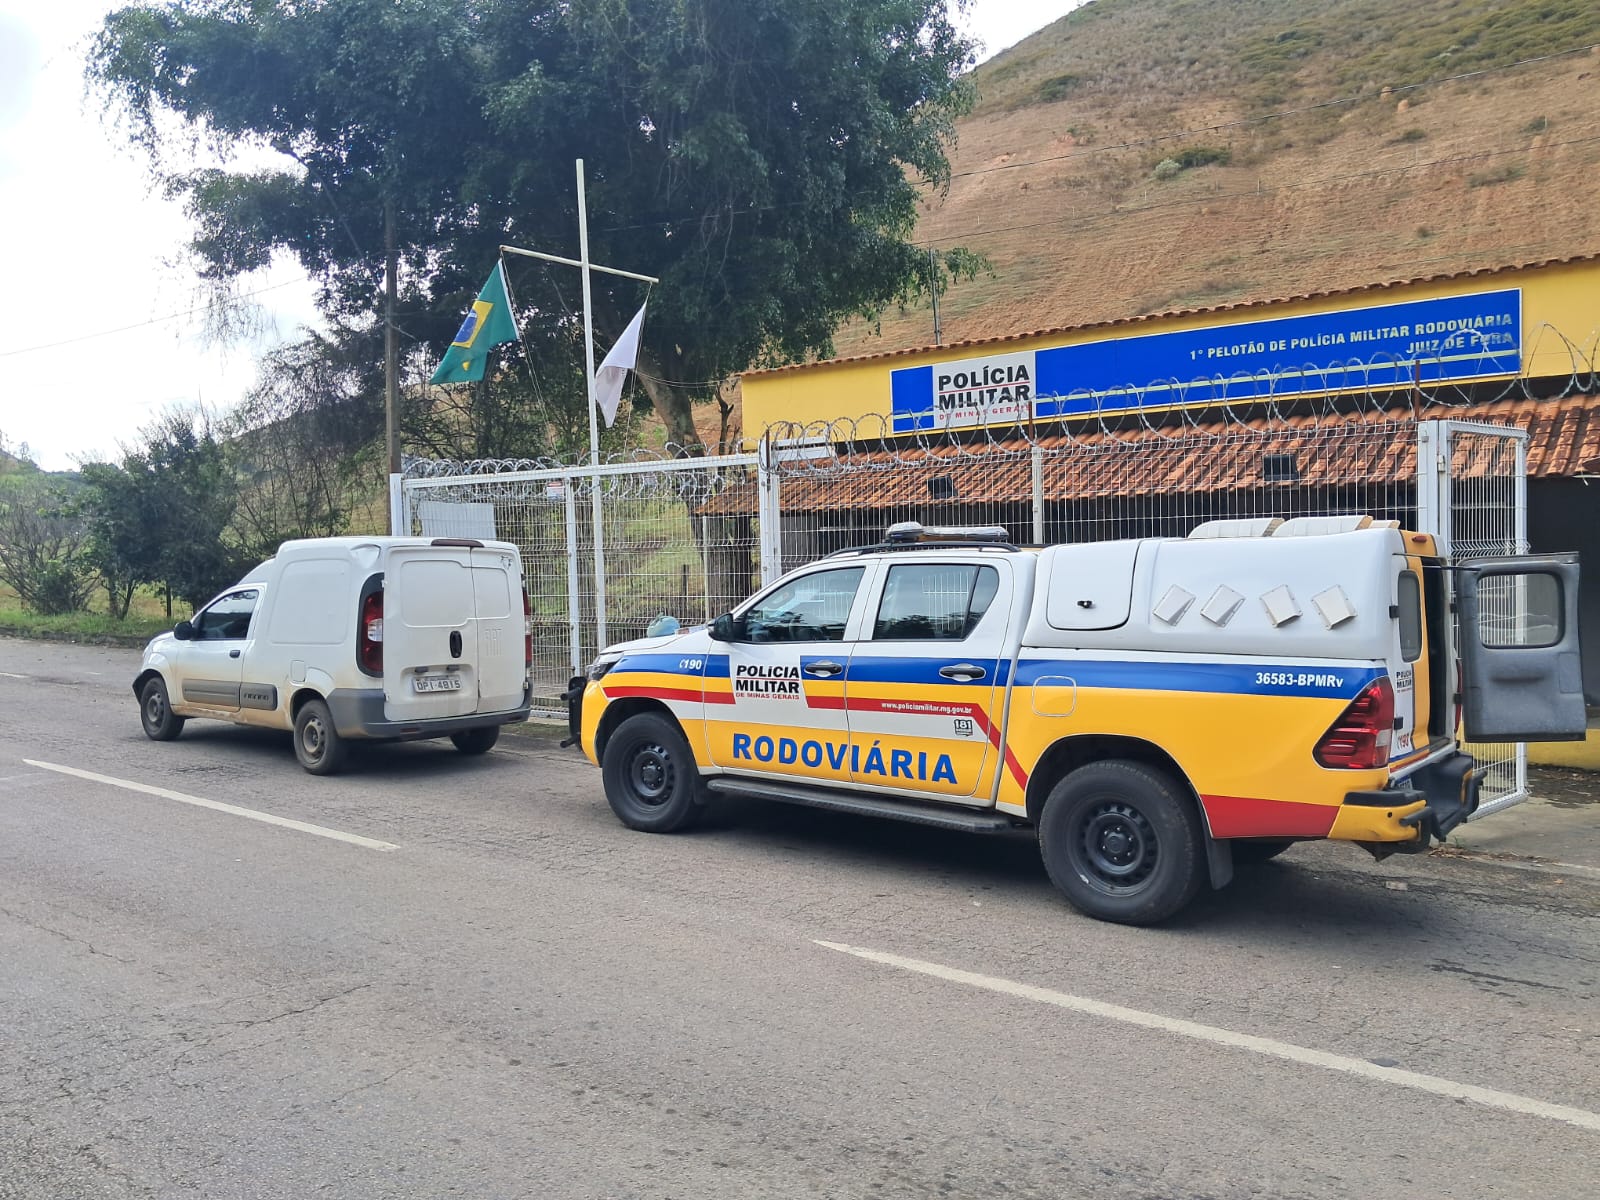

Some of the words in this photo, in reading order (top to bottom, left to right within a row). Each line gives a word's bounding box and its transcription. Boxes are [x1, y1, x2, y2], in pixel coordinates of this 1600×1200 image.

[1207, 340, 1265, 359] PELOTÃO
[1269, 339, 1288, 353] DE
[1290, 332, 1346, 350] POLÍCIA
[1350, 325, 1410, 343] MILITAR
[1414, 313, 1513, 336] RODOVIÁRIA
[1405, 339, 1440, 354] JUIZ
[1444, 336, 1465, 350] DE
[938, 364, 1030, 391] POLÍCIA
[938, 384, 1031, 411] MILITAR
[684, 657, 703, 671] 190
[735, 679, 800, 694] MILITAR
[1255, 671, 1344, 688] 36583-BPMRv
[747, 692, 770, 700] MINAS
[772, 693, 801, 701] GERAIS
[881, 702, 973, 715] www.policiamilitar.mg.gov.br
[954, 719, 972, 730] 181
[732, 732, 959, 785] RODOVIÁRIA
